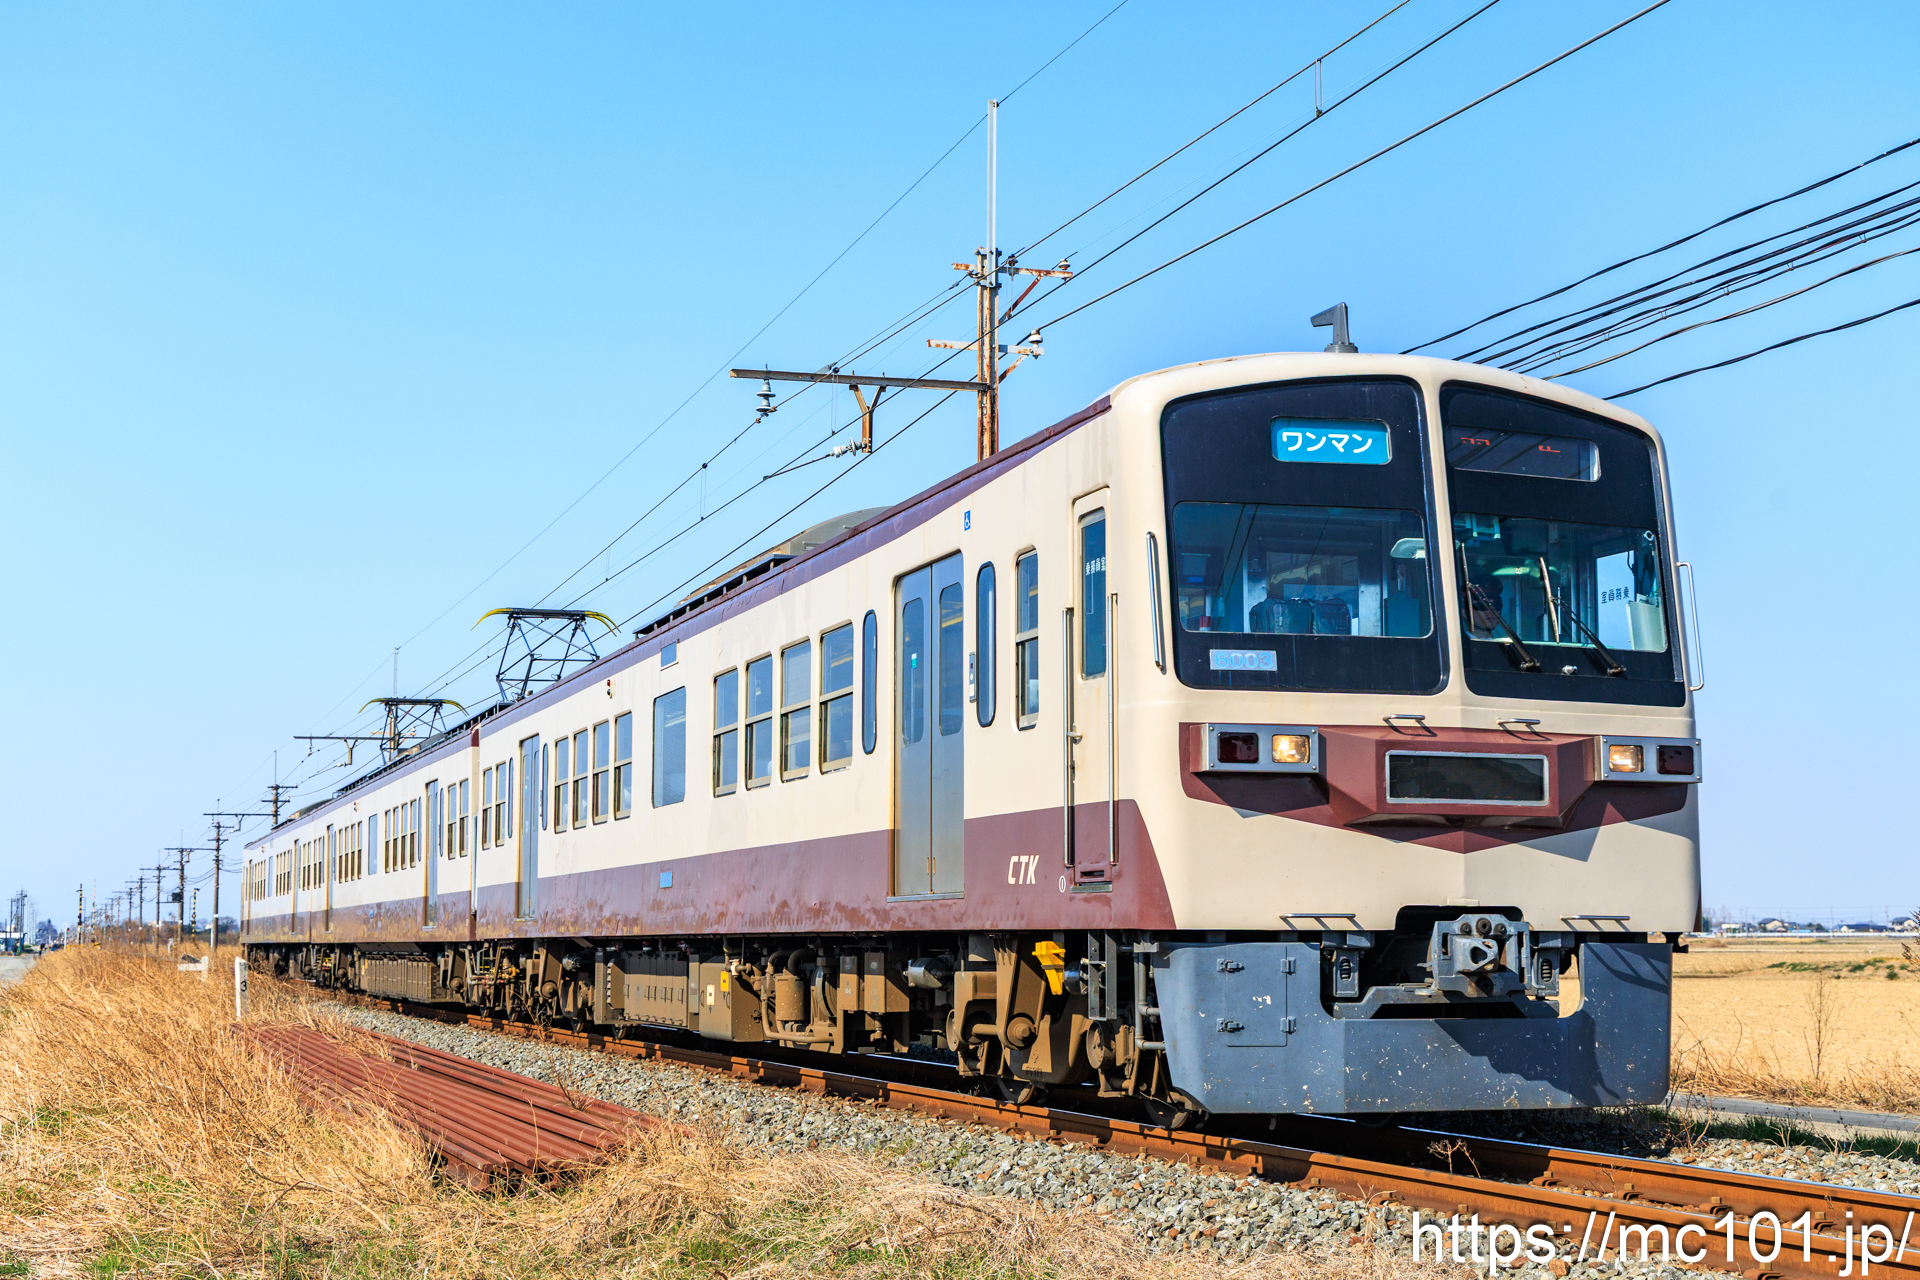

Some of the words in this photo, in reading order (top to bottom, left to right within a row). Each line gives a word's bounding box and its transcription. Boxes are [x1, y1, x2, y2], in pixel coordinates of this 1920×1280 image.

[1282, 431, 1373, 454] ワンマン
[1214, 652, 1273, 669] 6003
[1007, 854, 1040, 885] CTK
[241, 980, 248, 992] 3
